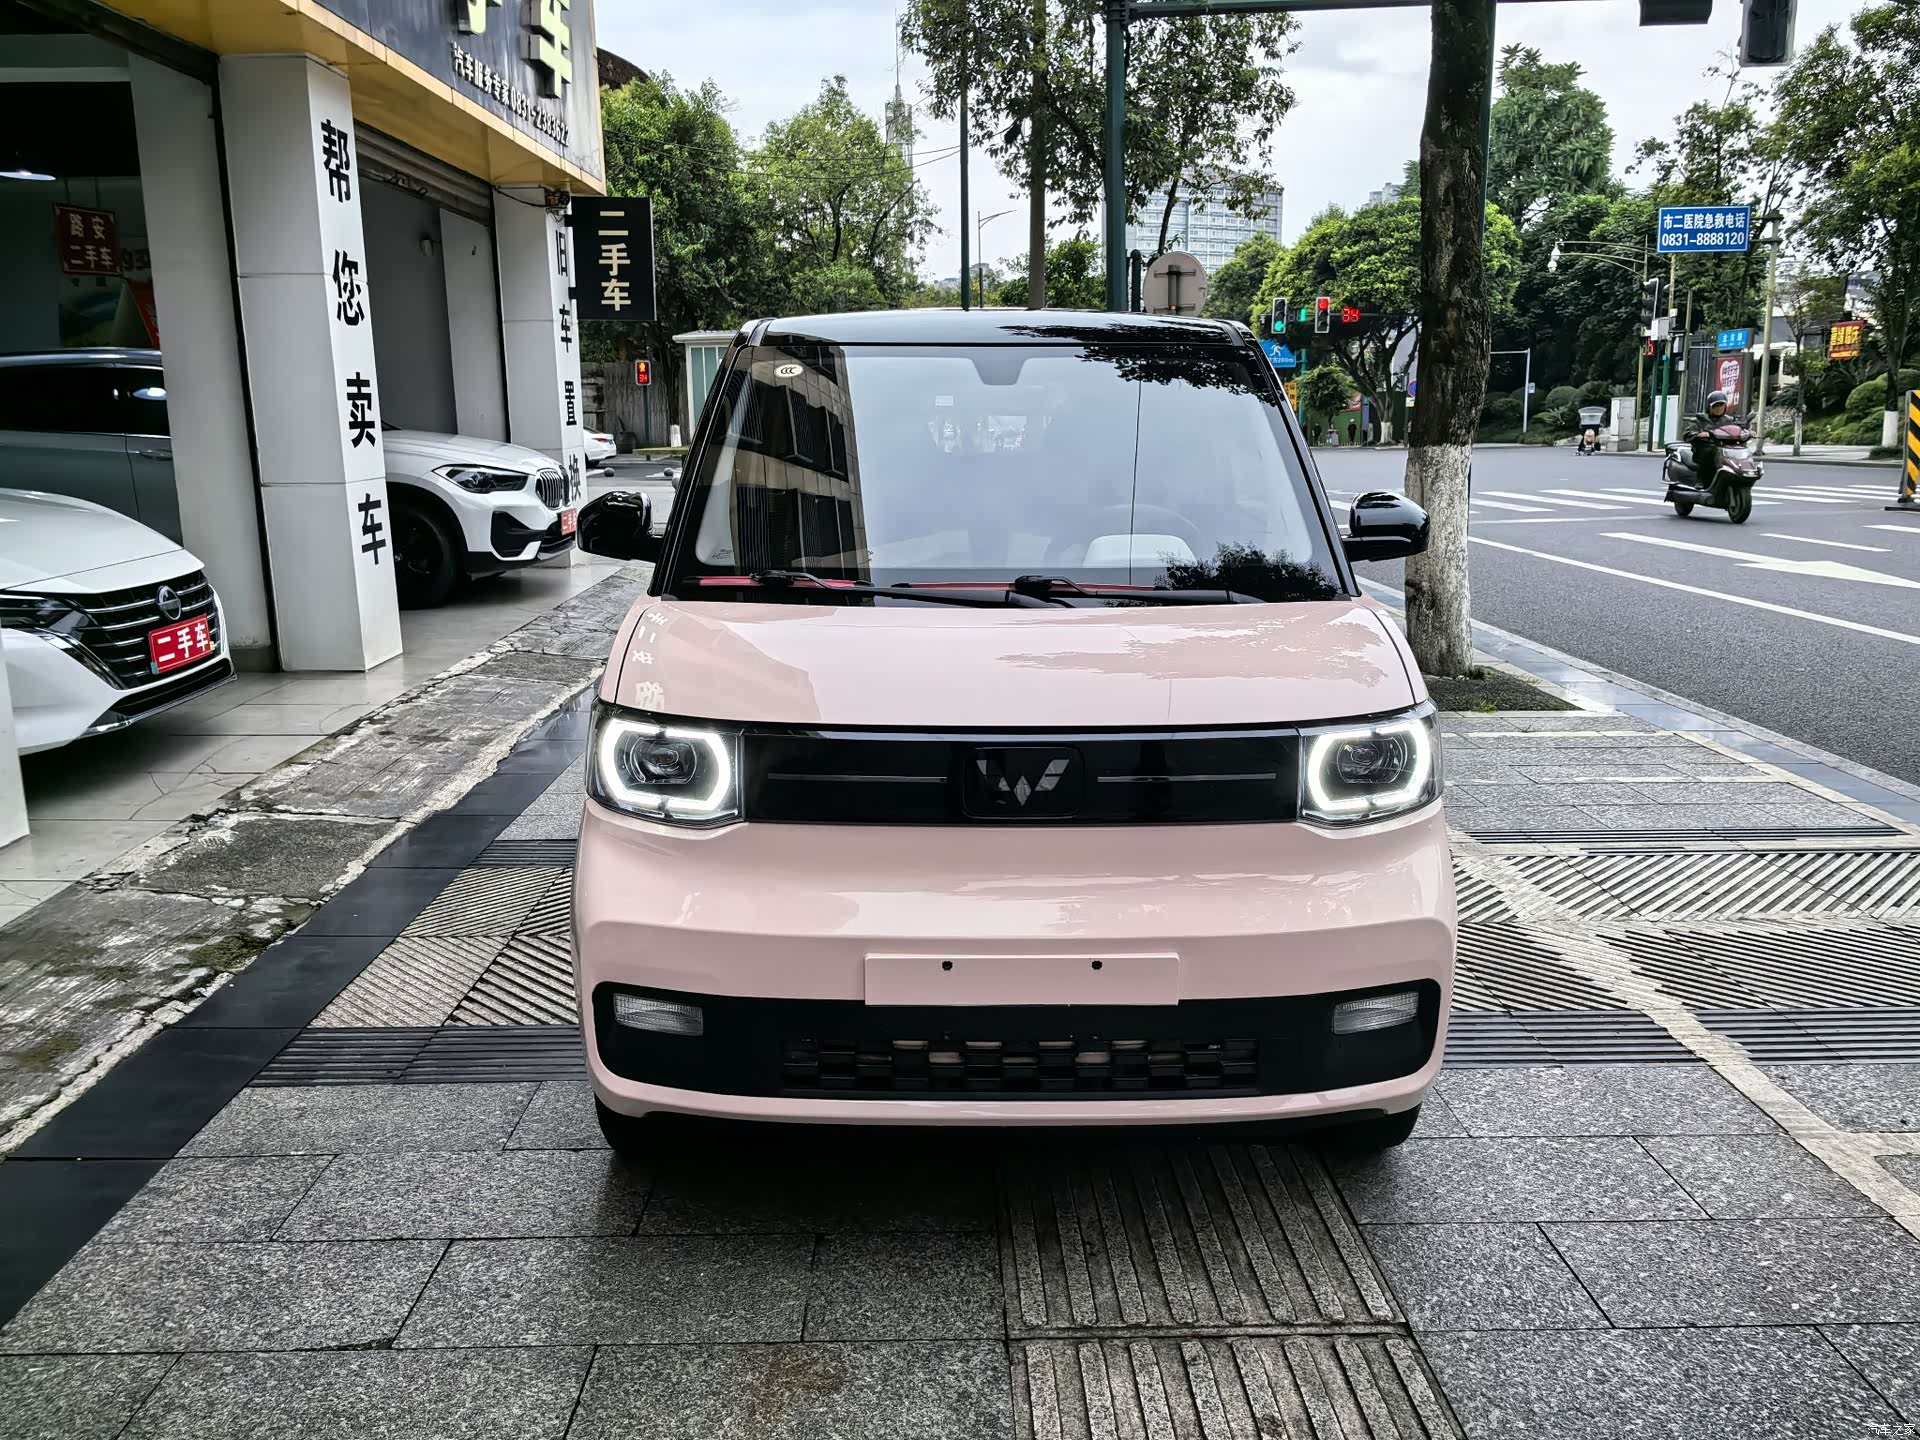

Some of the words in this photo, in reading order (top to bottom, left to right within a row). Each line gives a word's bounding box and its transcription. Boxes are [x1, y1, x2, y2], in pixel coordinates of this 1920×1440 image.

[453, 42, 510, 106] 汽车服务专家
[1661, 231, 1745, 247] 0831-8888120
[1663, 212, 1746, 230] 市二医院急救电话
[69, 244, 113, 271] 二手车
[598, 211, 631, 311] 二手车
[321, 119, 386, 565] 帮您卖车
[157, 622, 209, 662] 二手车
